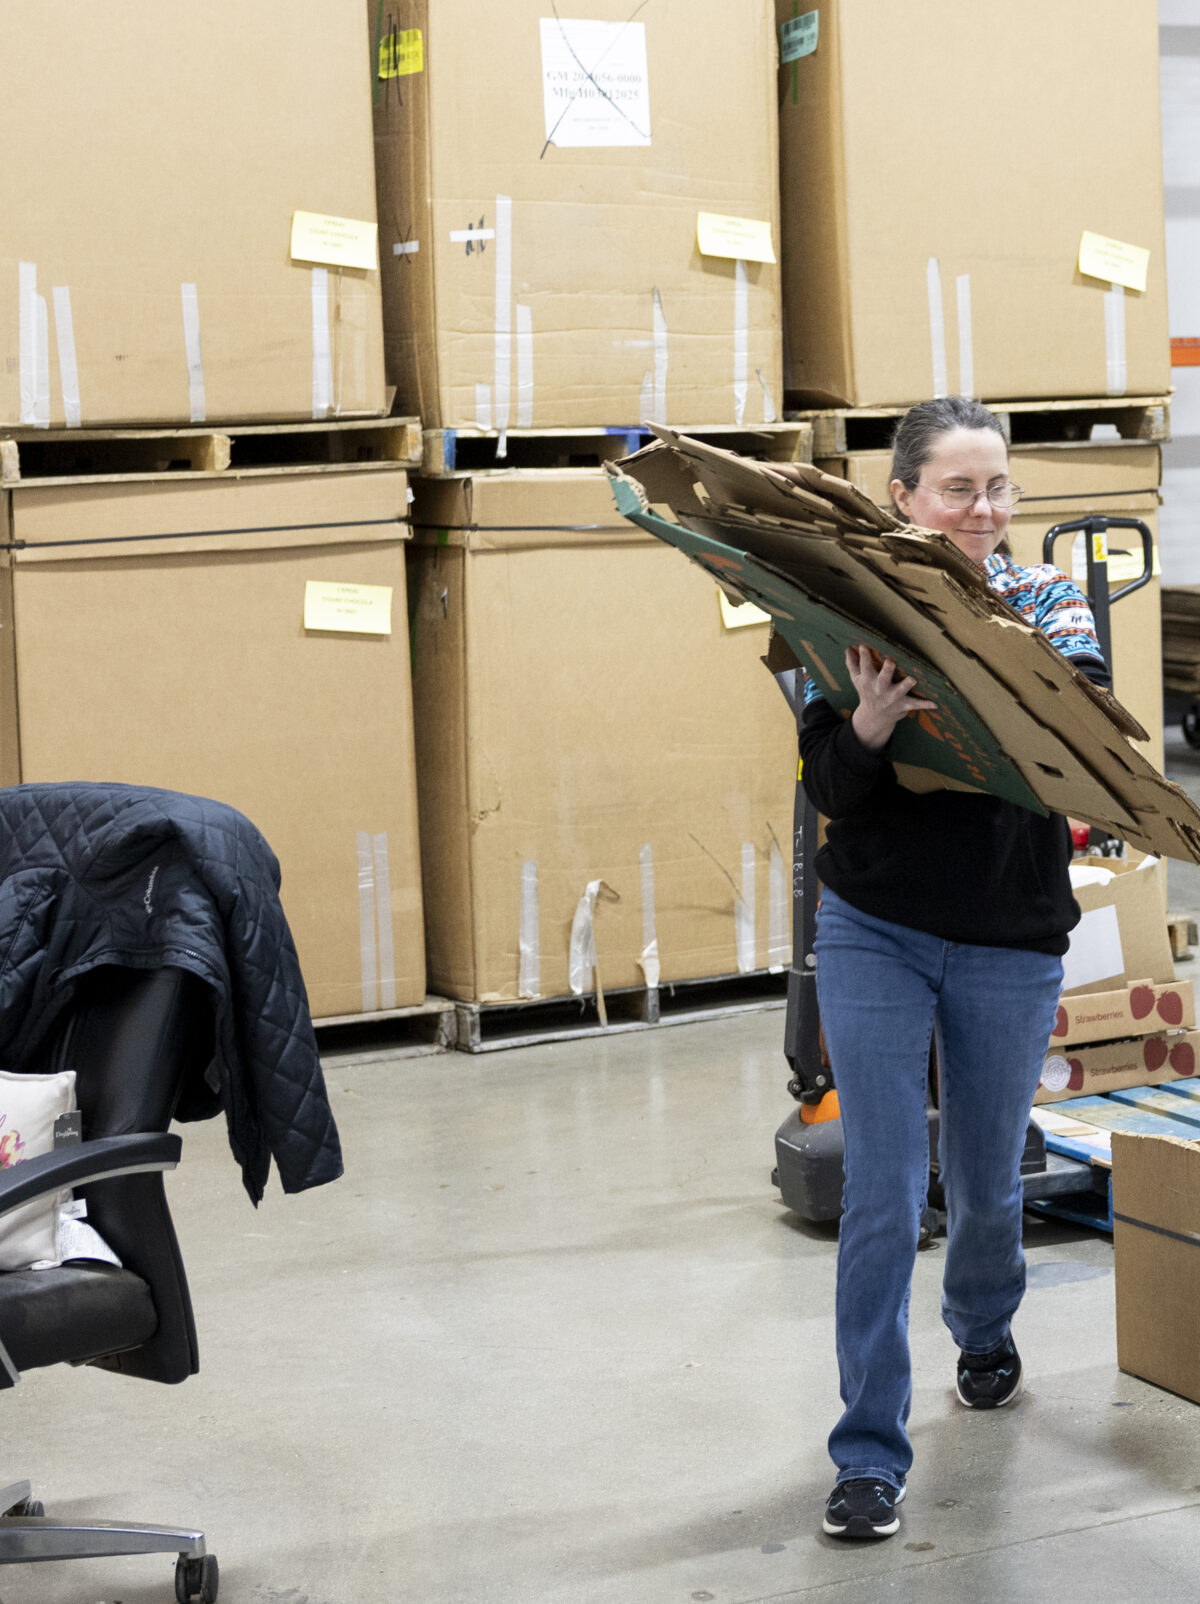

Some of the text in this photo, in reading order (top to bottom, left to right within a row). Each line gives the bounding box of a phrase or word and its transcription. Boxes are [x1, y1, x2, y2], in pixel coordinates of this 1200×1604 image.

[547, 70, 568, 82] GM
[1075, 1011, 1124, 1025] Strawberries
[1090, 1062, 1138, 1077] Strawberries
